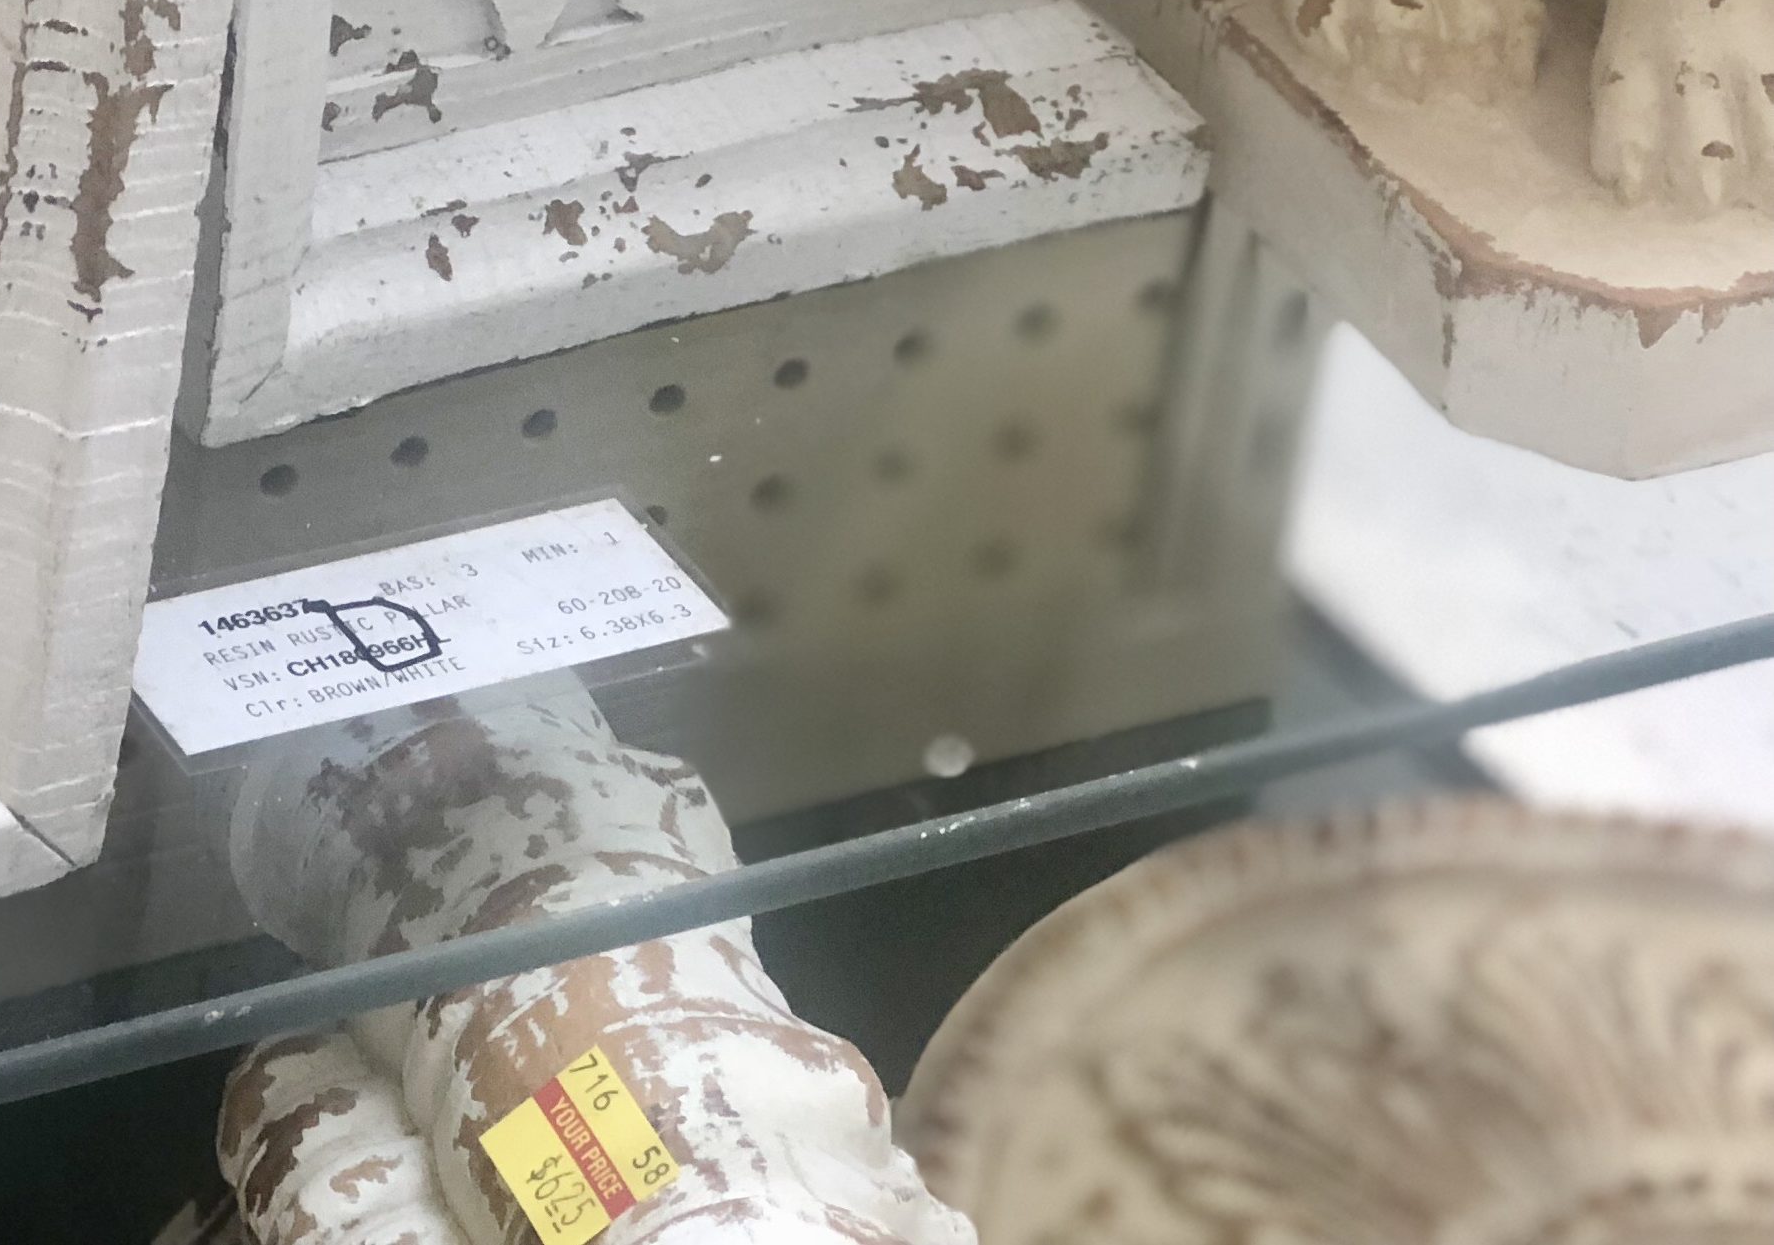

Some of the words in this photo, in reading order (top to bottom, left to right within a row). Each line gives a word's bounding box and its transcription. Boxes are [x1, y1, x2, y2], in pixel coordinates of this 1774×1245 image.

[379, 575, 436, 597] BAS:
[460, 563, 478, 578] 3
[521, 542, 578, 564] MIN:
[603, 531, 619, 546] 1
[198, 598, 308, 635] 1463637
[557, 575, 682, 615] 60-208-20
[203, 639, 276, 666] RESIN
[287, 617, 374, 647] RUSTIC
[384, 594, 471, 624] PLAR
[223, 669, 282, 692] VSN:
[307, 657, 467, 704] BROWN/WHITE
[568, 1053, 619, 1111] 716
[632, 1145, 670, 1185] 58
[549, 1096, 592, 1152] YOUR
[580, 1145, 624, 1200] PRICE
